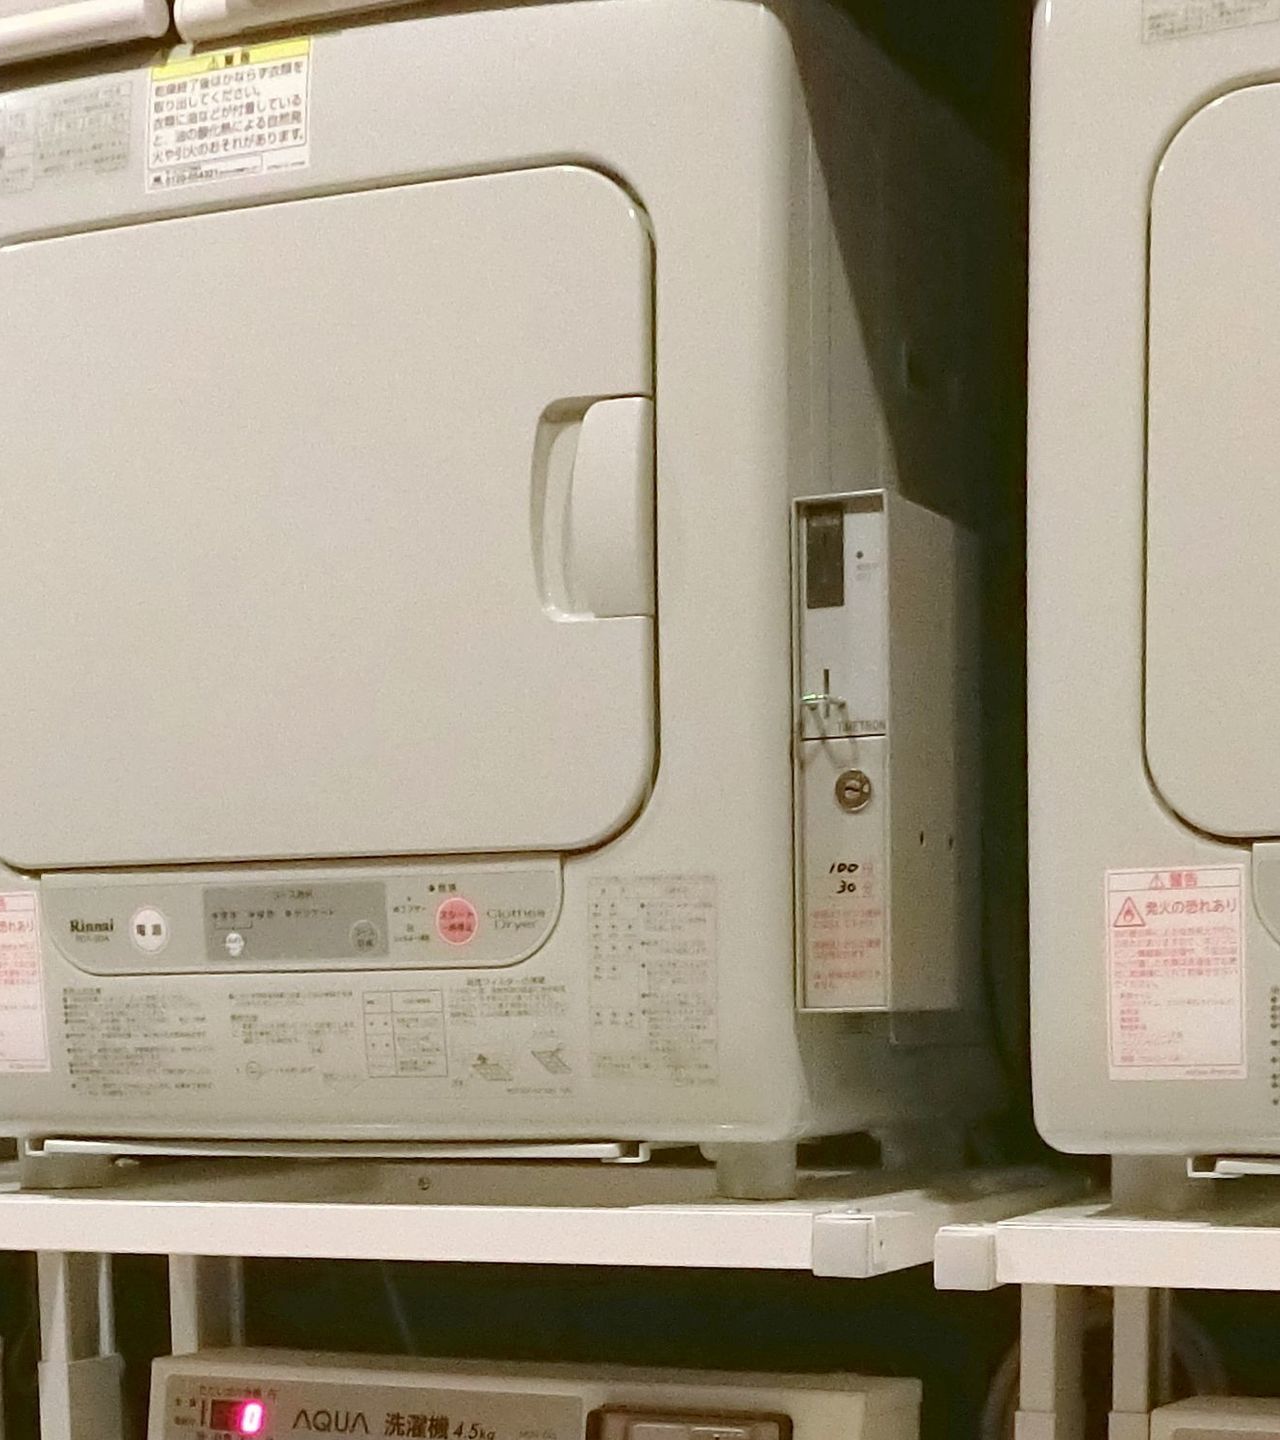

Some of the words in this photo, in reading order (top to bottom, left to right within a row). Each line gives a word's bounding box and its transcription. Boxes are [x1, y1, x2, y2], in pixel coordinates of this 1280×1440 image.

[829, 862, 859, 874] 100
[836, 880, 856, 894] 30
[1169, 871, 1198, 888] 警告
[1145, 897, 1238, 915] 発火の恐れあり
[70, 918, 114, 933] Rinnai
[242, 1404, 263, 1432] 0
[292, 1409, 369, 1435] AQUA
[384, 1412, 450, 1440] 洗濯機
